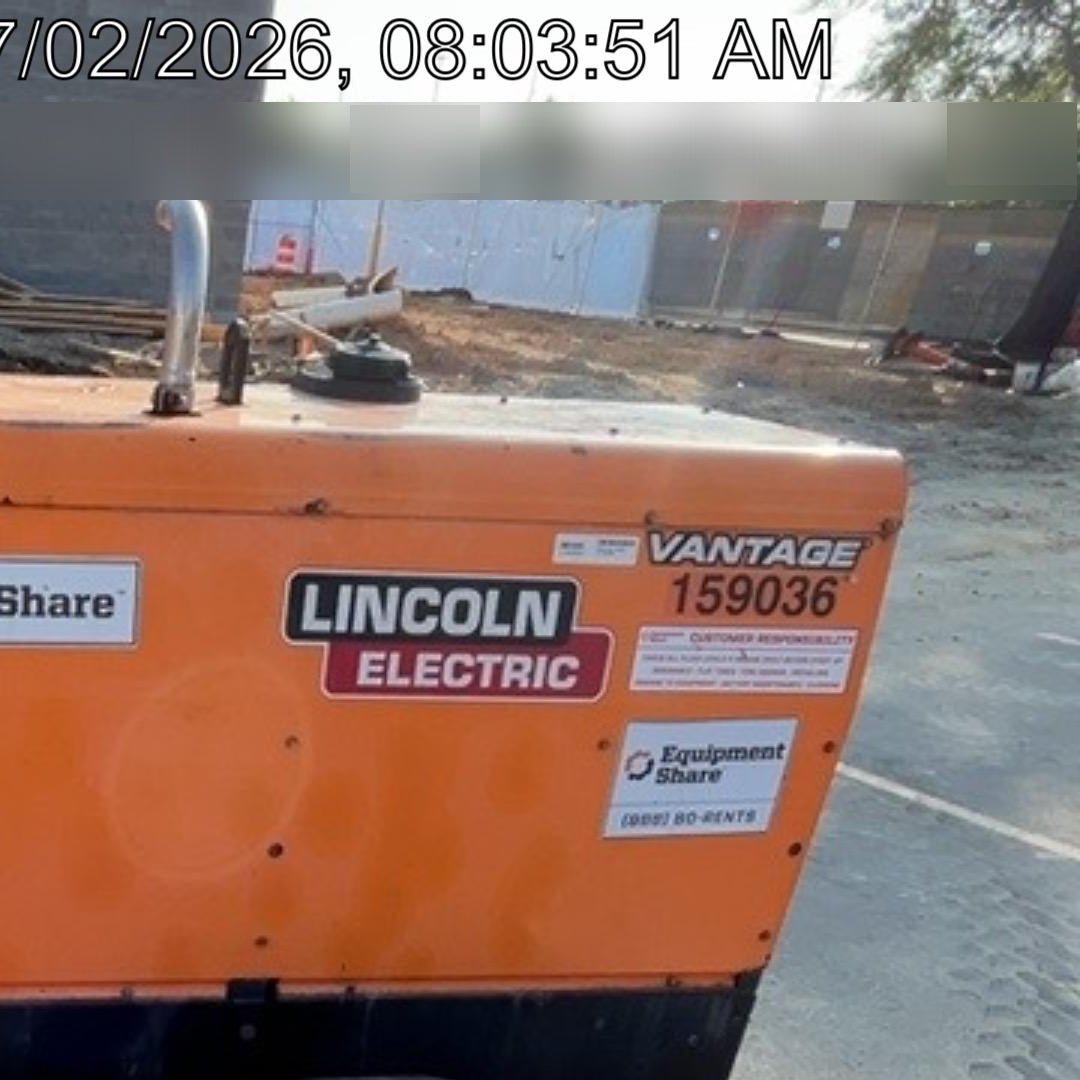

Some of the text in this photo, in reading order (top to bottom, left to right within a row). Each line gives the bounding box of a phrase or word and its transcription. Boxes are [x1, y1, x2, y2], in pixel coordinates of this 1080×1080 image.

[648, 533, 864, 569] VANTAGE
[301, 584, 562, 638] LINCOLN
[672, 573, 839, 617] 159036
[689, 632, 752, 643] CUSTOMER
[356, 651, 581, 690] ELECTRIC
[660, 743, 787, 766] Equipment
[655, 767, 724, 785] Share
